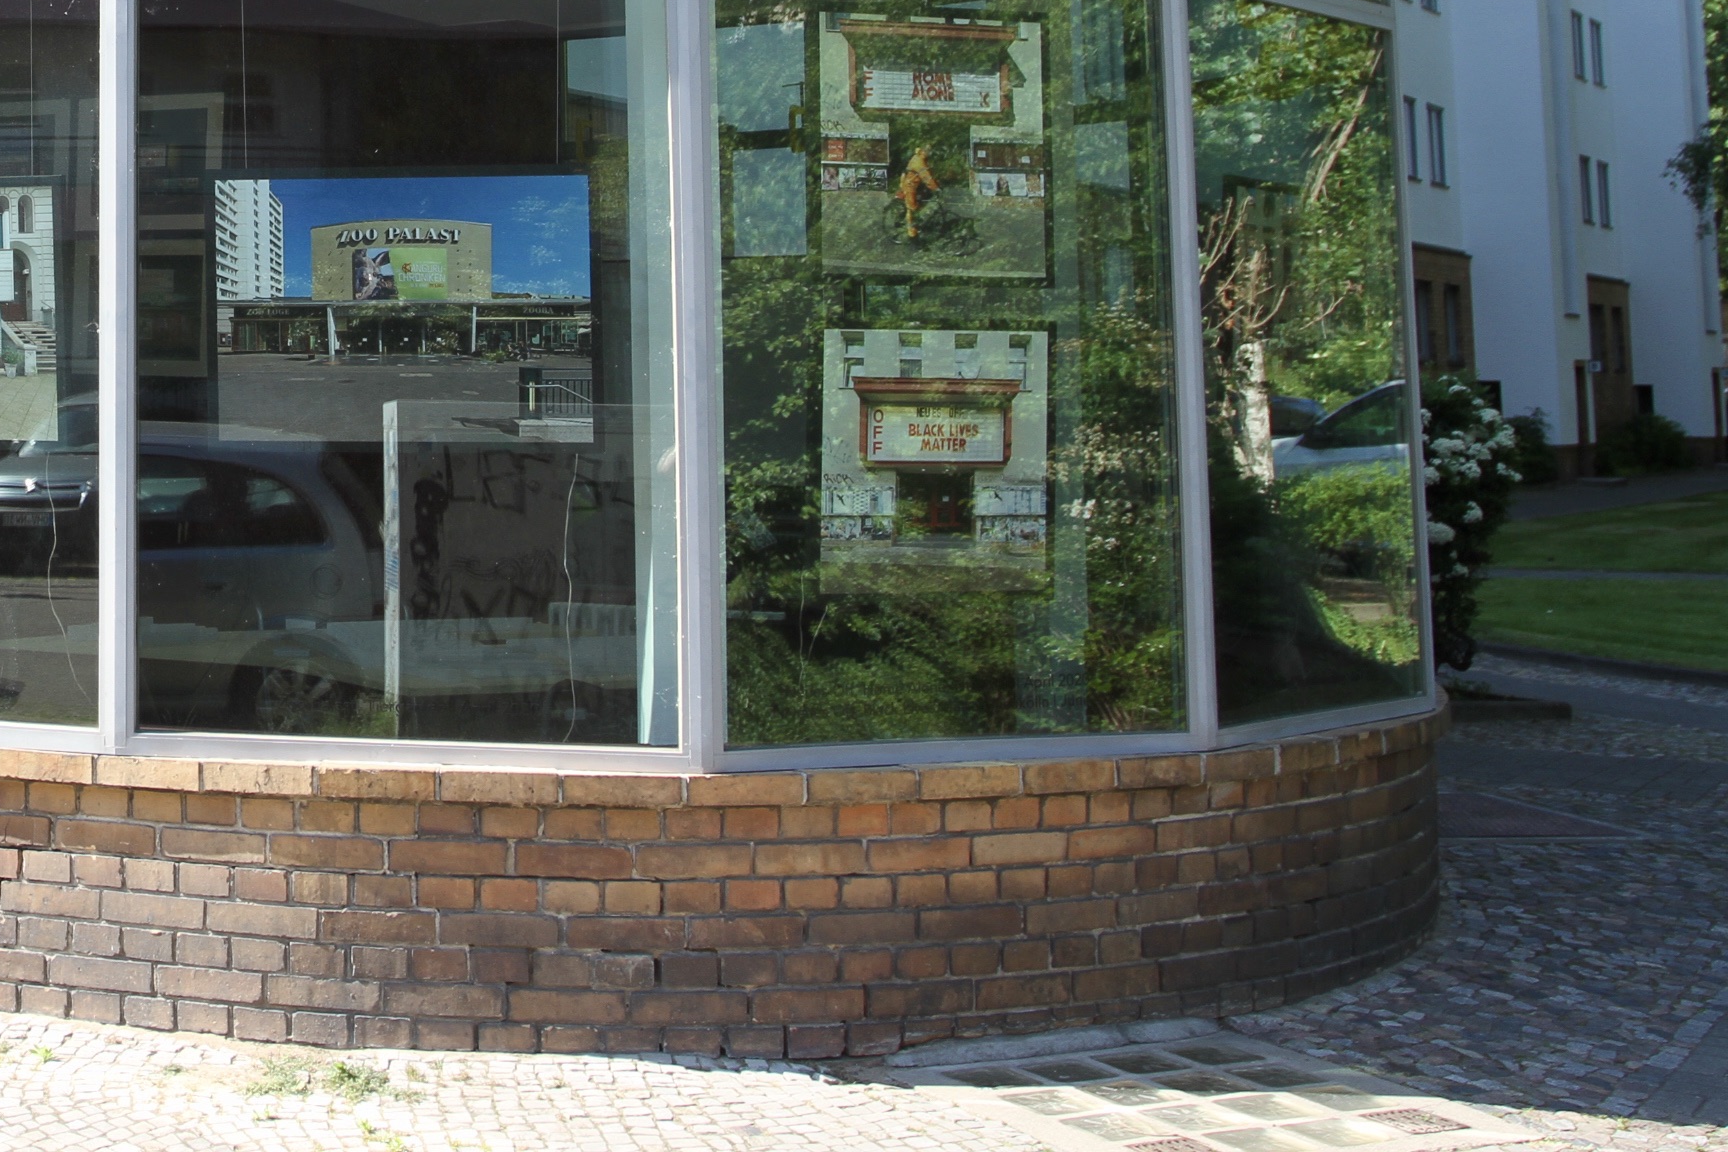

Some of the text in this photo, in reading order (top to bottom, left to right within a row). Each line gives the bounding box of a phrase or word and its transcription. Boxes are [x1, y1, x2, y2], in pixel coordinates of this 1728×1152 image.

[338, 227, 460, 244] ZOO PALAST
[908, 423, 980, 437] BLACK LIVES
[920, 437, 967, 452] MATTER
